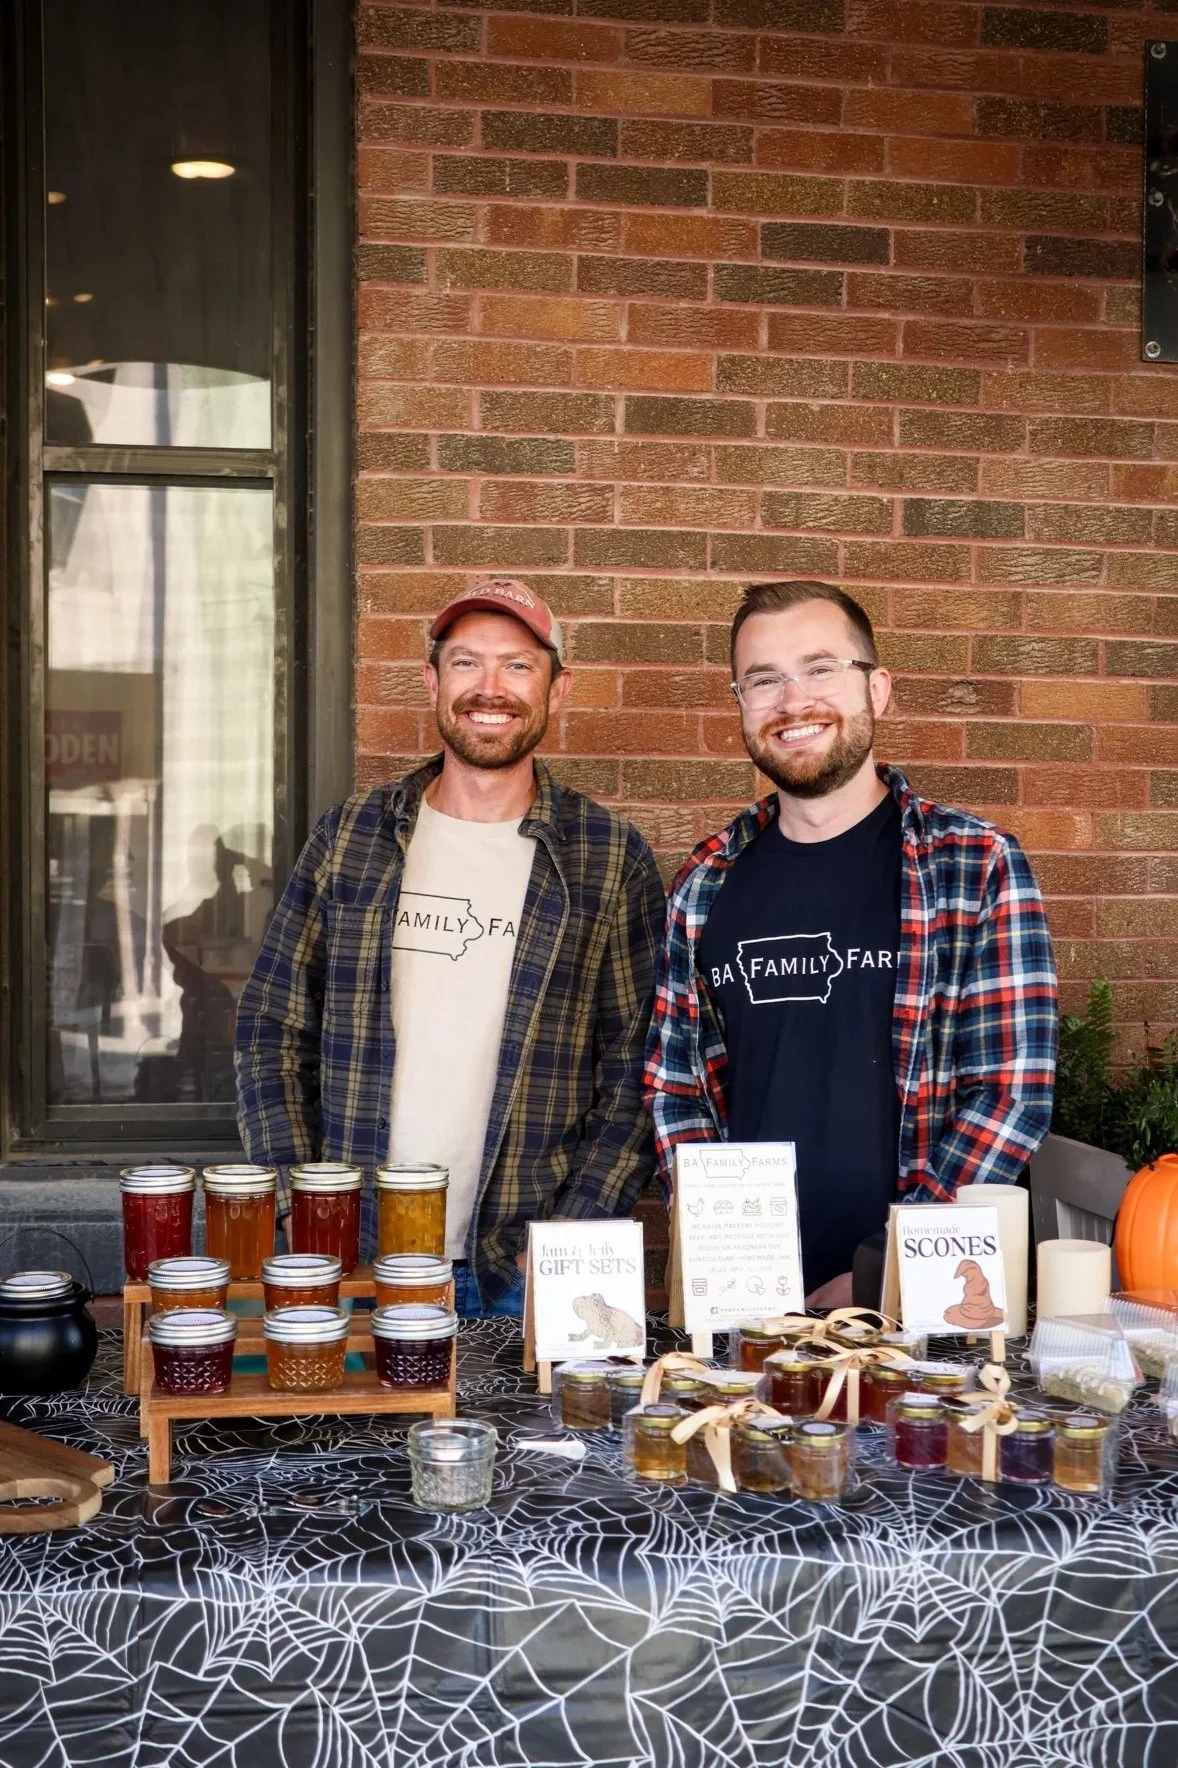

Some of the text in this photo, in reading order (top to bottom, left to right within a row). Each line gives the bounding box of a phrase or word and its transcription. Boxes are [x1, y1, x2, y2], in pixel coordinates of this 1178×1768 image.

[494, 588, 535, 608] BARN
[397, 911, 469, 934] AMILY
[711, 948, 900, 988] BA FAMILY FAR
[684, 1156, 787, 1168] BA FAMILY FARMS
[903, 1223, 960, 1236] Homemade
[539, 1242, 614, 1258] Jam & Jelly
[904, 1235, 997, 1258] SCONES
[539, 1257, 637, 1276] GIFT SETS
